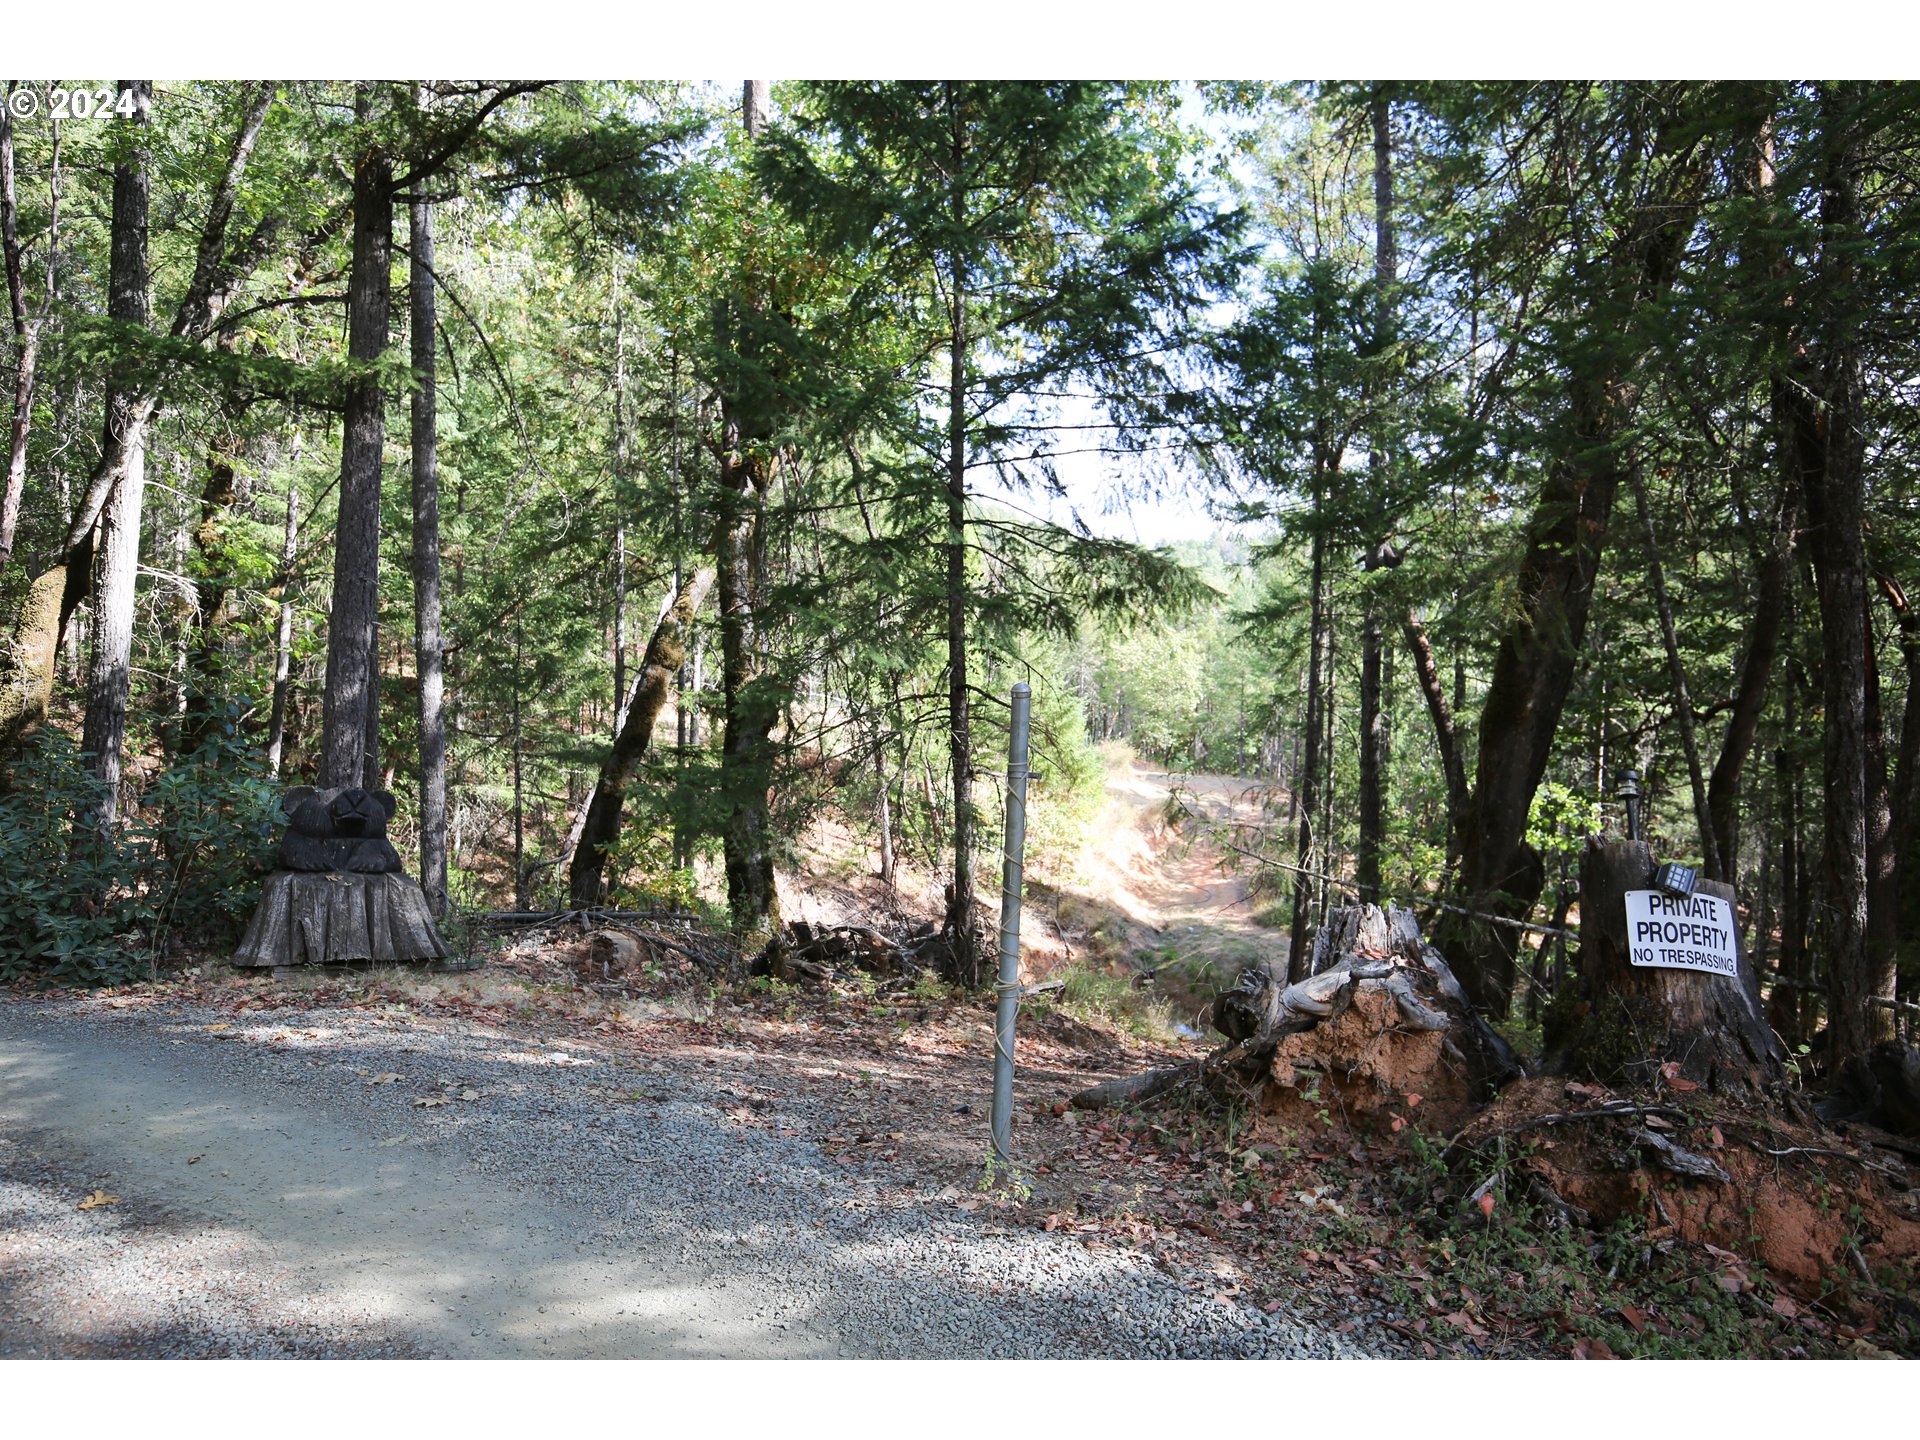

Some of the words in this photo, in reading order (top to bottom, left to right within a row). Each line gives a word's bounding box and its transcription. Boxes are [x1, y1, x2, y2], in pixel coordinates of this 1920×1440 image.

[1648, 895, 1718, 922] PRIVATE
[1637, 921, 1728, 951] PROPERTY
[1633, 948, 1654, 962] NO
[1659, 949, 1734, 972] TRESPASSING
